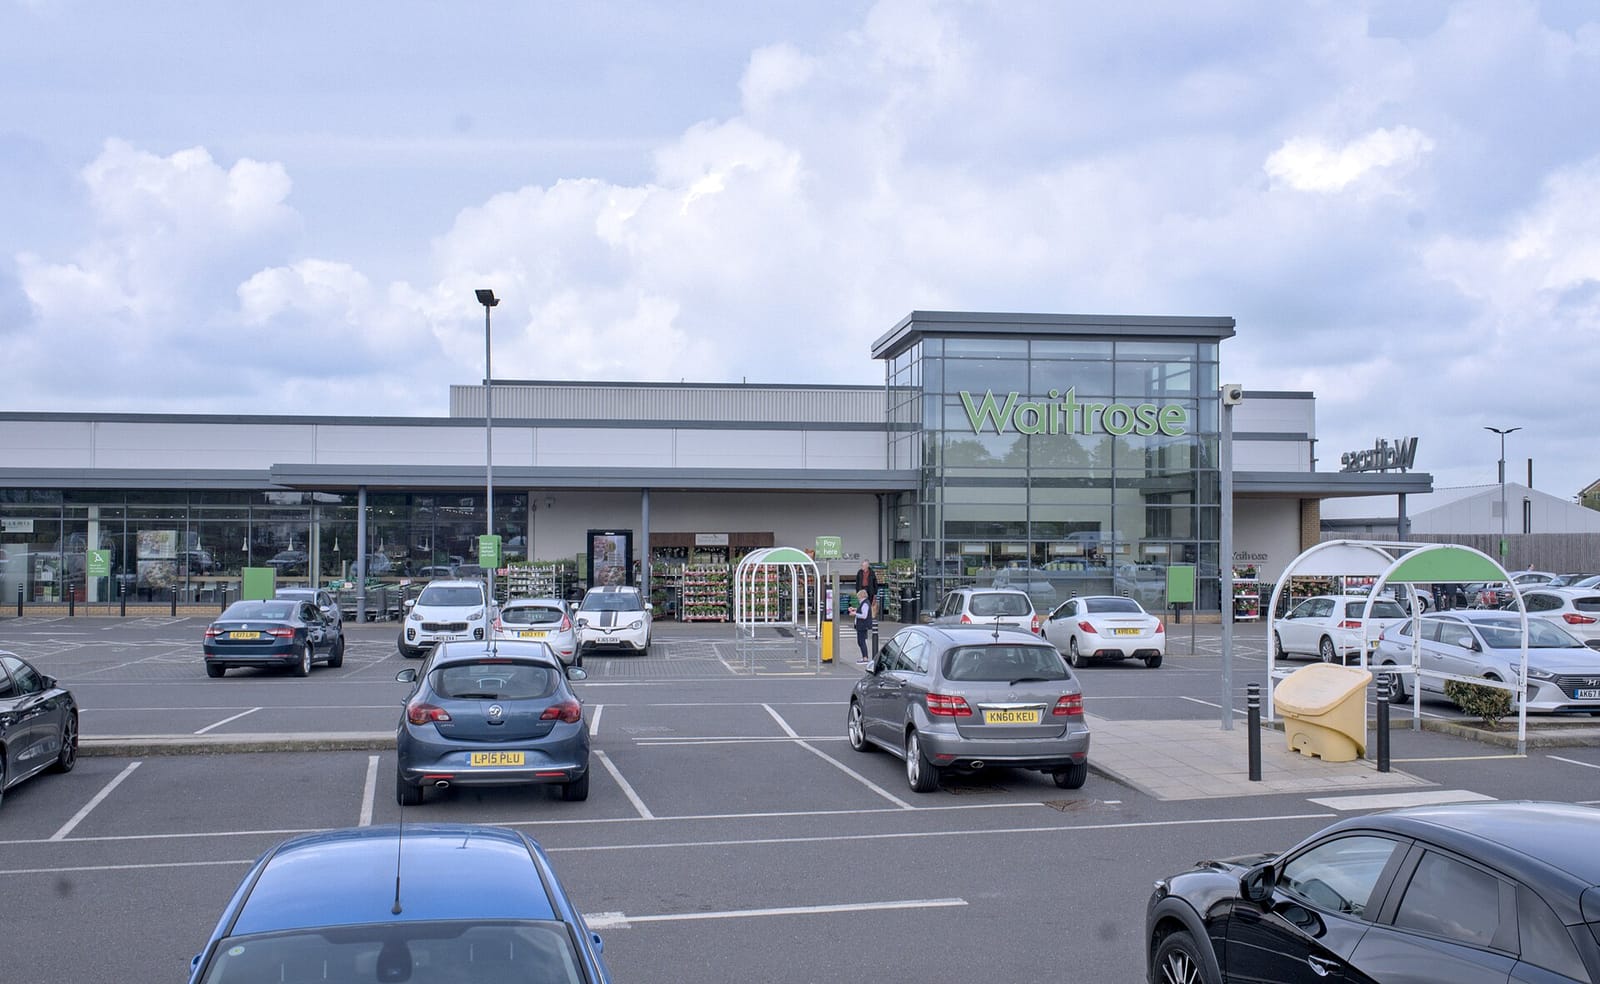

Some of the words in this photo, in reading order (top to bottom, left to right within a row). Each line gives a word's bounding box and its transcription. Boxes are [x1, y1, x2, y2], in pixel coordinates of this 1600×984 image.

[959, 385, 1187, 436] Waitrose
[823, 540, 836, 548] Pay
[1579, 689, 1597, 698] AK67
[990, 712, 1014, 722] KN60
[1016, 712, 1034, 722] KEU
[474, 753, 497, 764] LP15
[500, 753, 520, 764] PLU
